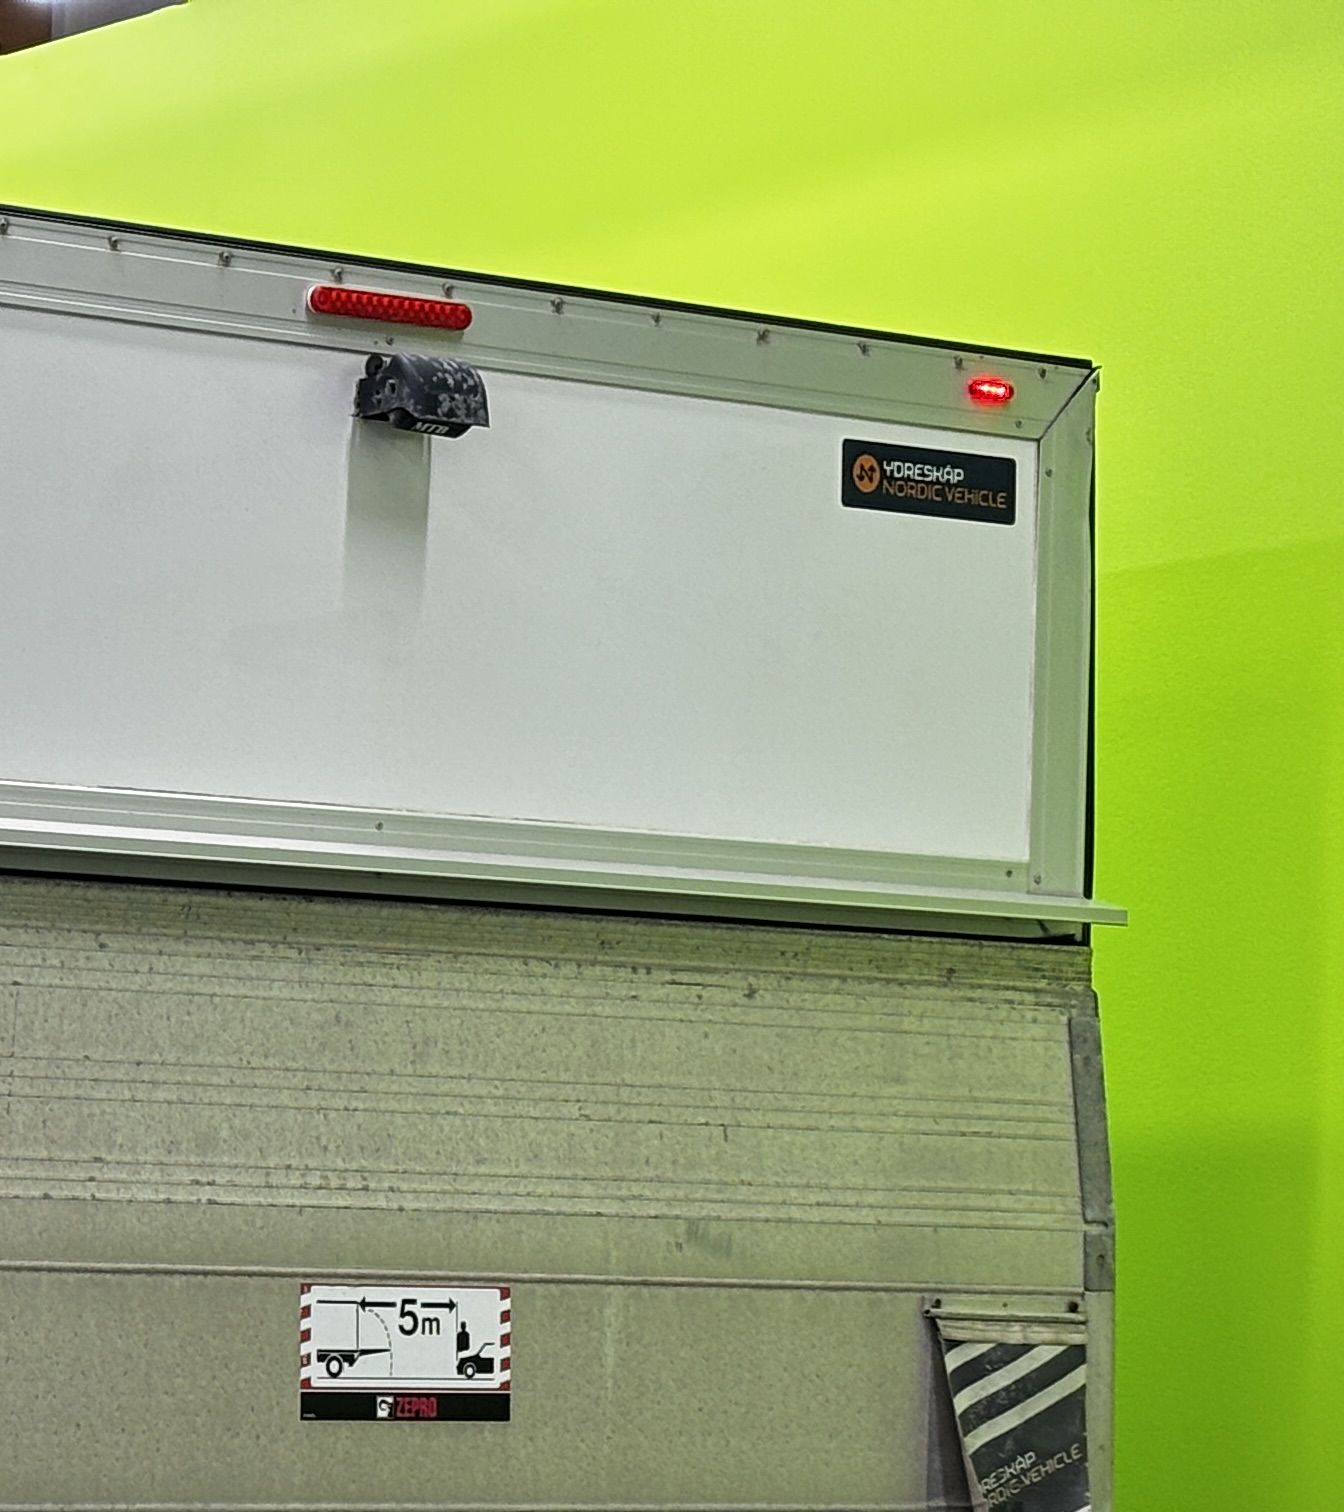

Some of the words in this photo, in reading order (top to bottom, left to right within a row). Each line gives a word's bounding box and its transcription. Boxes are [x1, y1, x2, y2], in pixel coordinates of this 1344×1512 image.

[883, 460, 964, 484] YDRESKÅP
[882, 479, 942, 501] NORDIC
[944, 487, 1007, 509] VEHICLE
[396, 1396, 438, 1418] ZEPRO
[981, 1451, 1037, 1494] RESKÅP
[985, 1478, 1021, 1507] RDIC
[1020, 1443, 1083, 1485] VEHICLE
